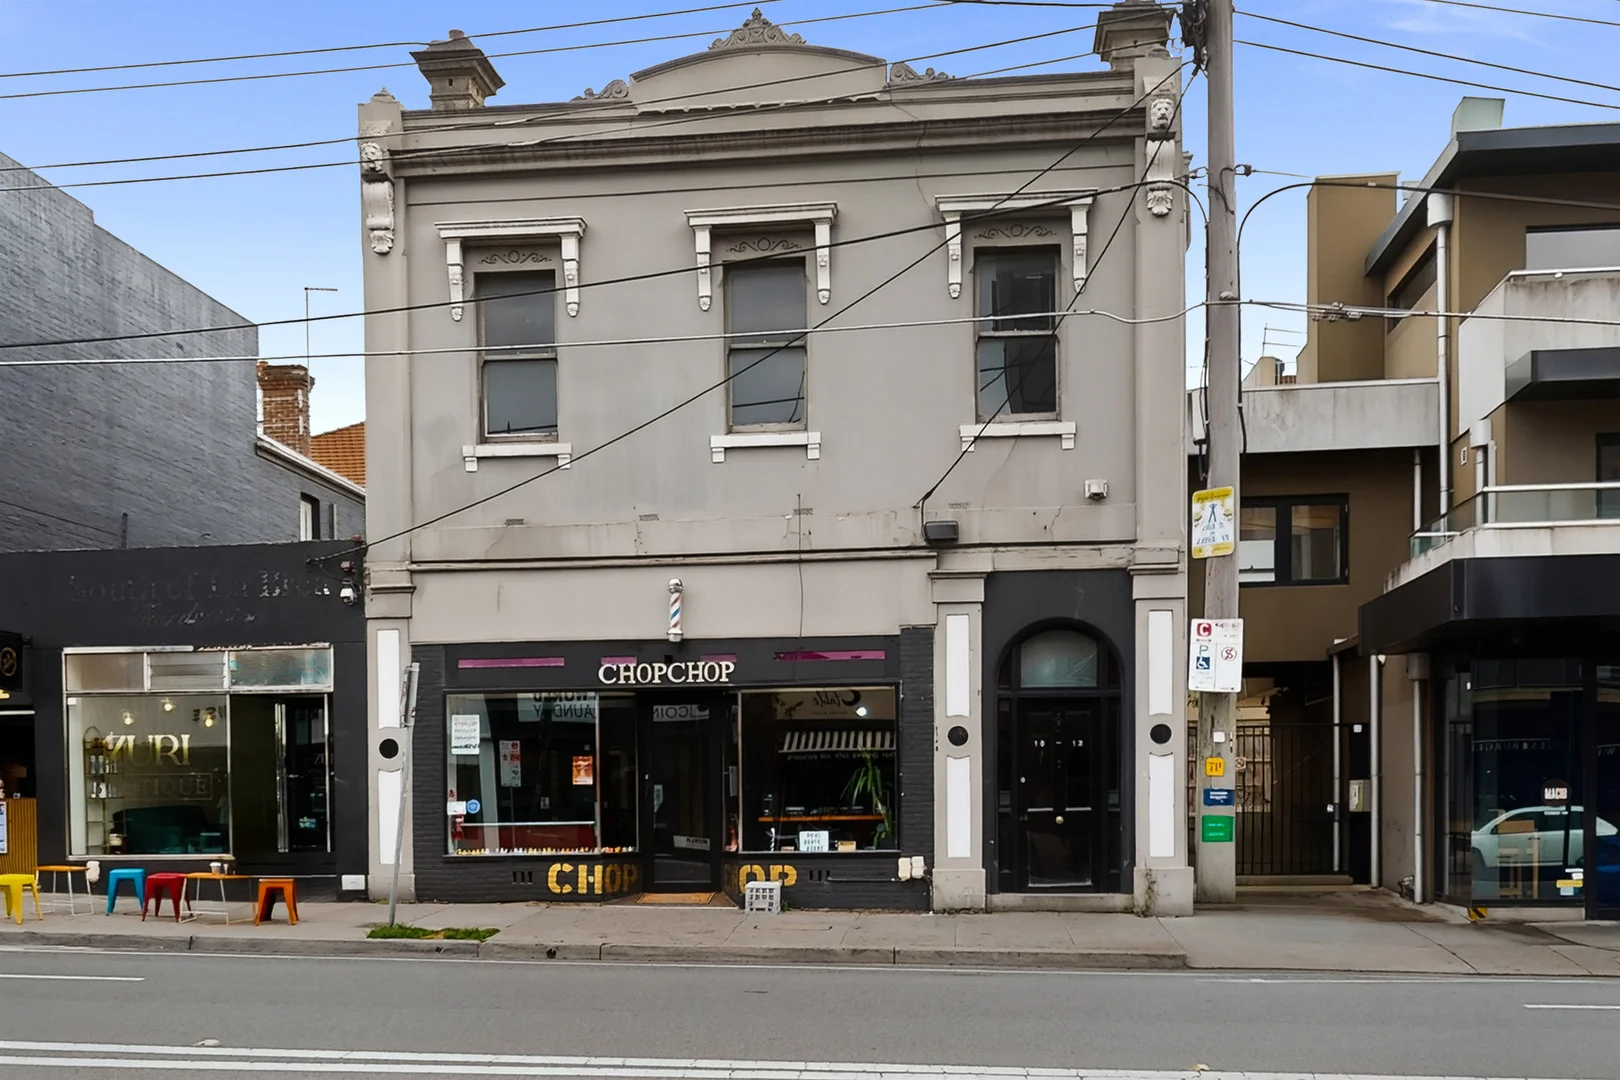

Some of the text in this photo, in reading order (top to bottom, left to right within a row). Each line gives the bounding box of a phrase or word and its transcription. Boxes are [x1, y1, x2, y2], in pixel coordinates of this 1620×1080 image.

[598, 661, 735, 684] CHOPCHOP
[104, 734, 190, 766] ZURI
[547, 863, 638, 894] CHOP
